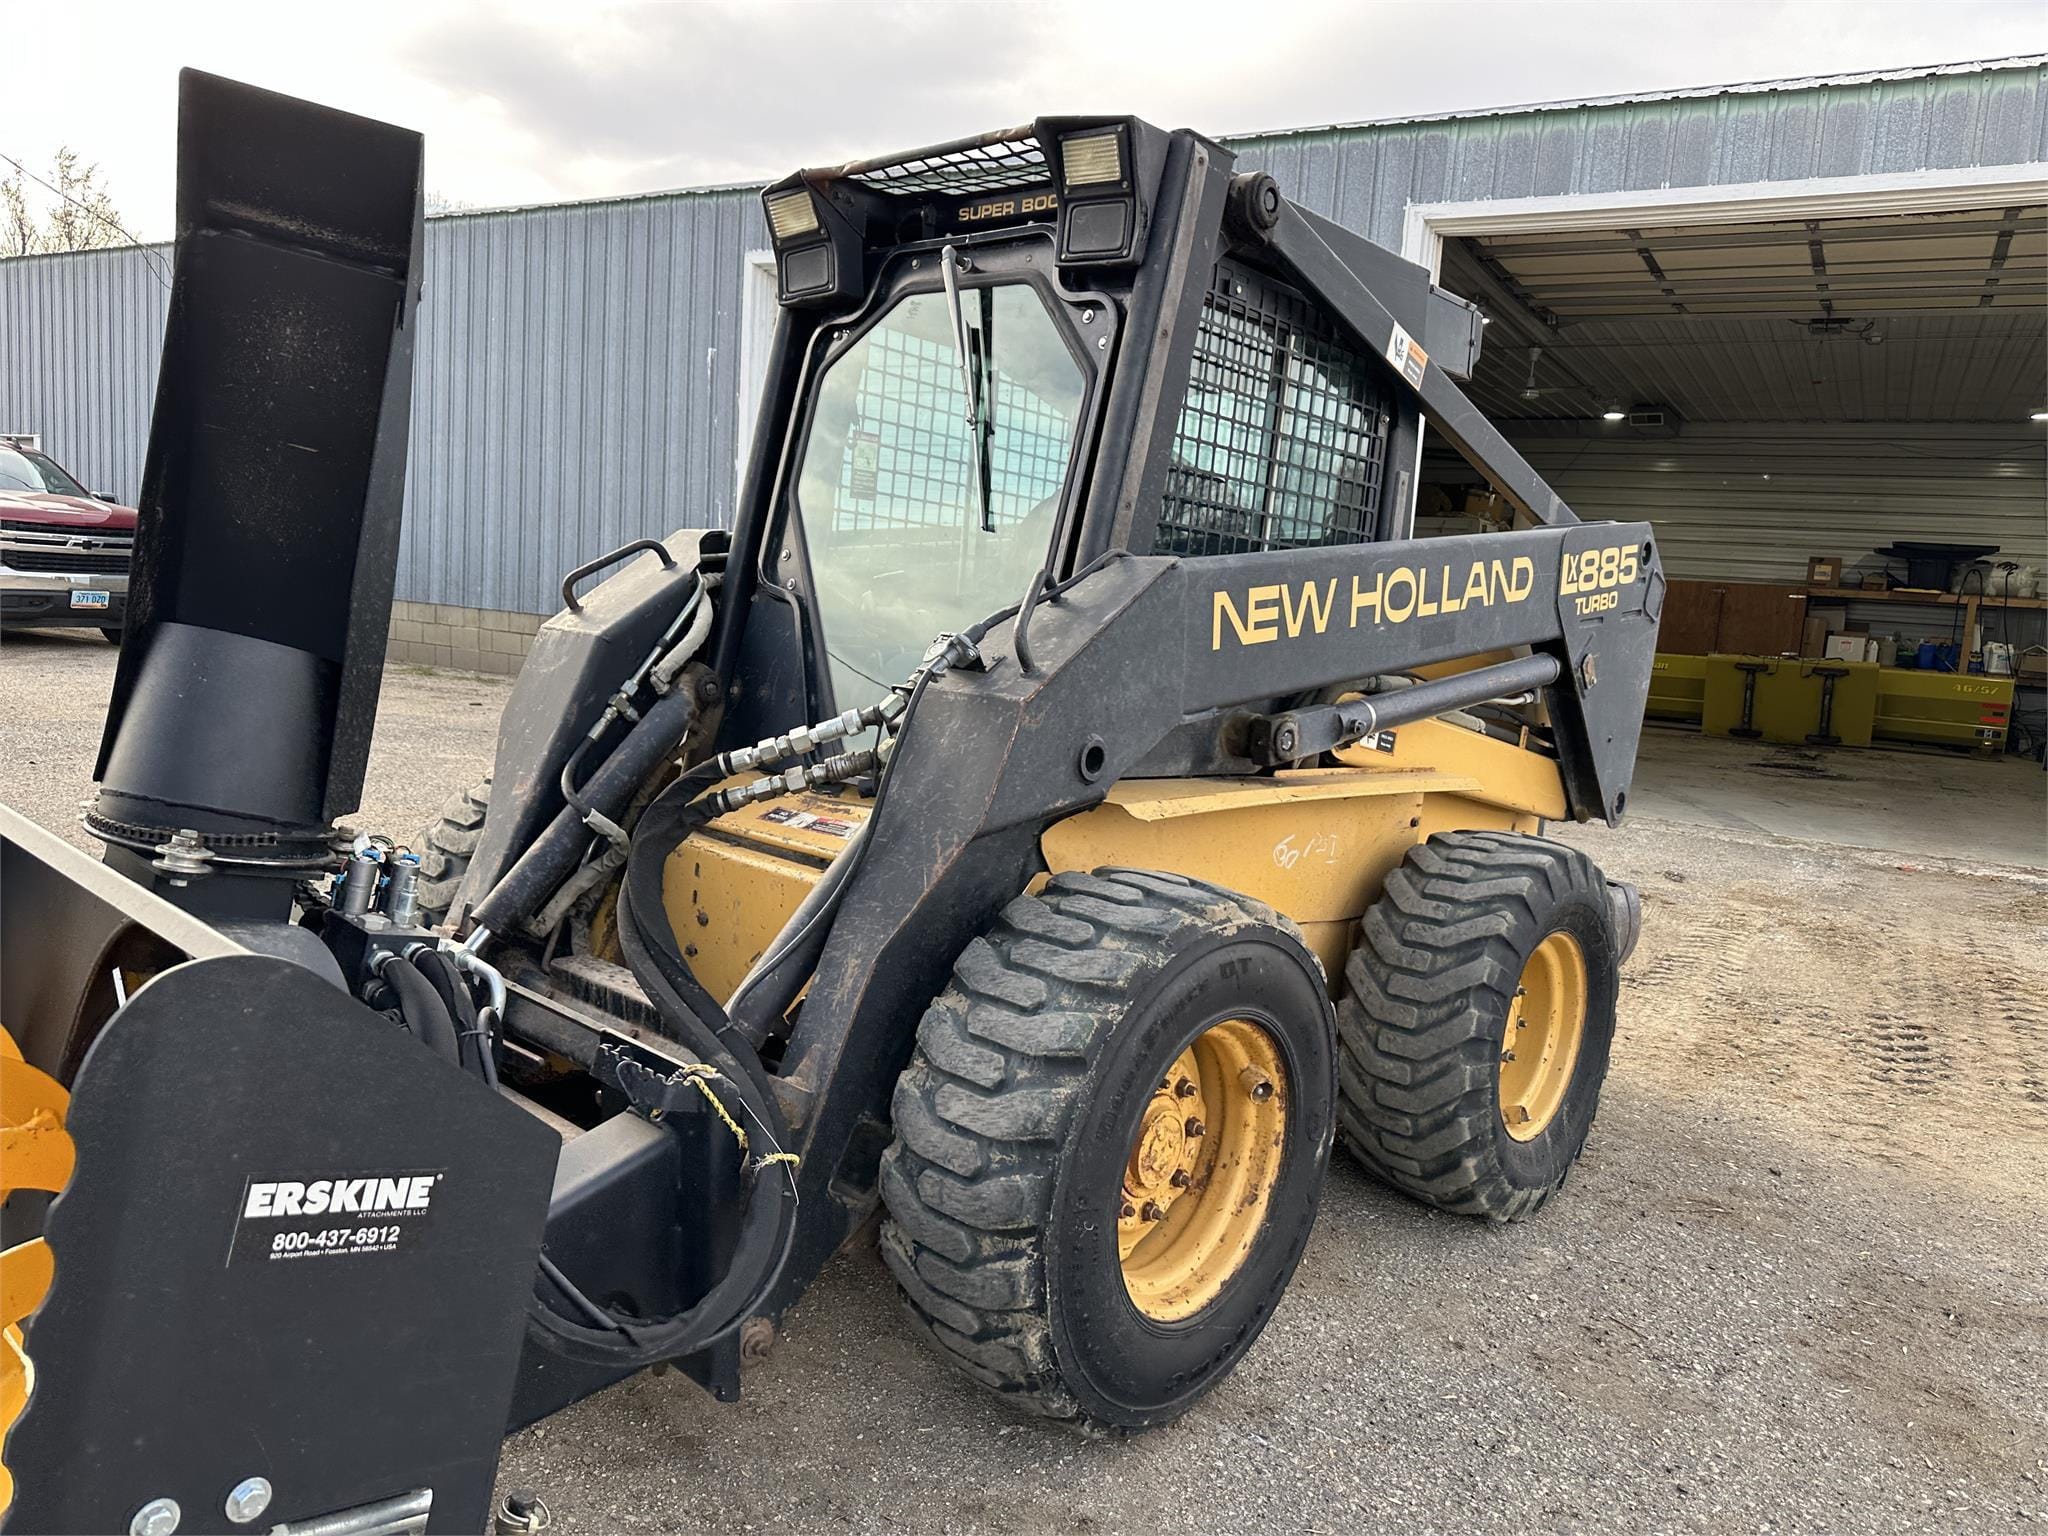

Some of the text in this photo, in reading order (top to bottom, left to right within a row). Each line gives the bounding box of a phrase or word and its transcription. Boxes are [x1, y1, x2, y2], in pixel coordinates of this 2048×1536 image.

[958, 194, 1058, 221] SUPER BOO
[1212, 556, 1534, 651] NEW HOLLAND
[1575, 591, 1619, 616] TURBO
[244, 1176, 435, 1219] ERSKINE
[357, 1208, 427, 1218] ATTACHMENTS LLC
[272, 1225, 400, 1251] 800-437-6912
